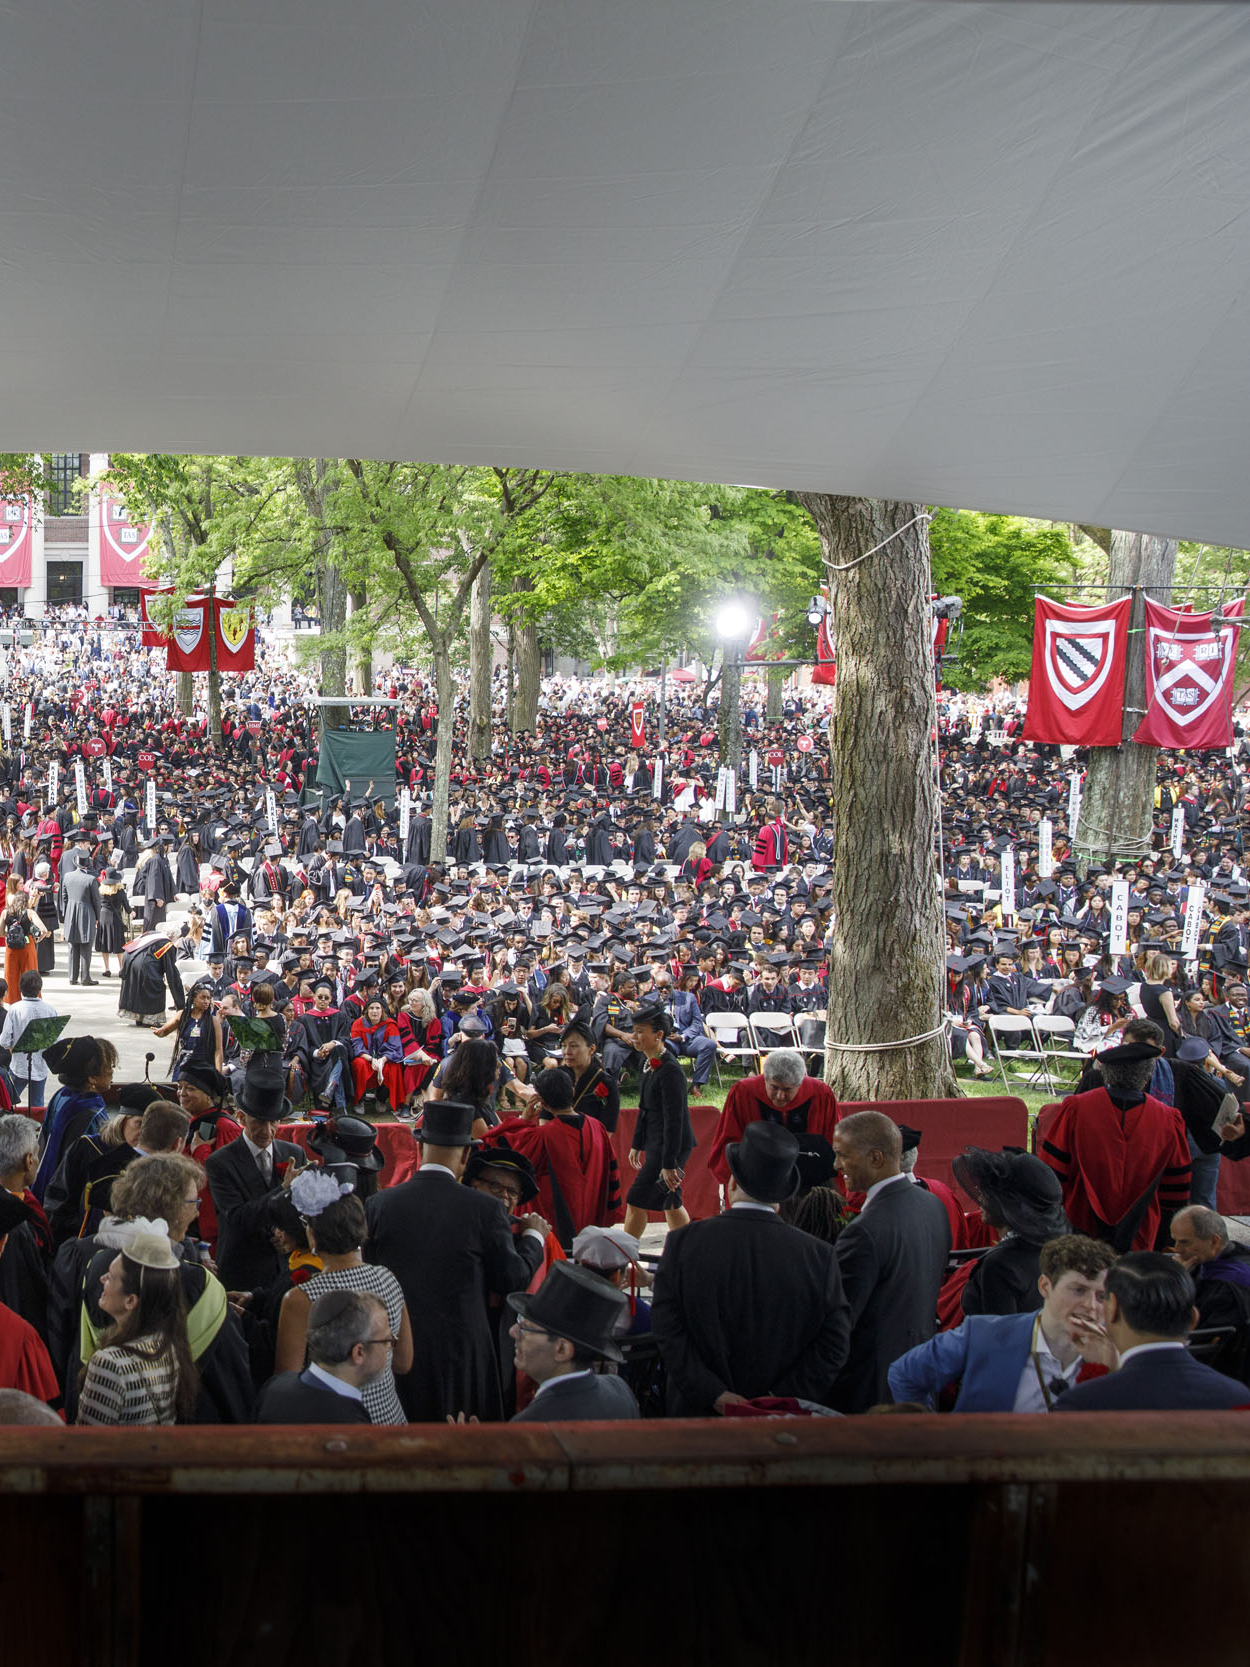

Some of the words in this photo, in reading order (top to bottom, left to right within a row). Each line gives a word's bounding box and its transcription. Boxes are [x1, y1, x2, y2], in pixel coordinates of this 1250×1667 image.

[123, 531, 136, 539] TAS
[1178, 691, 1194, 700] TAS
[78, 768, 86, 811] KIRKLAND
[1115, 894, 1123, 942] CABOT
[1185, 905, 1195, 944] CABOT
